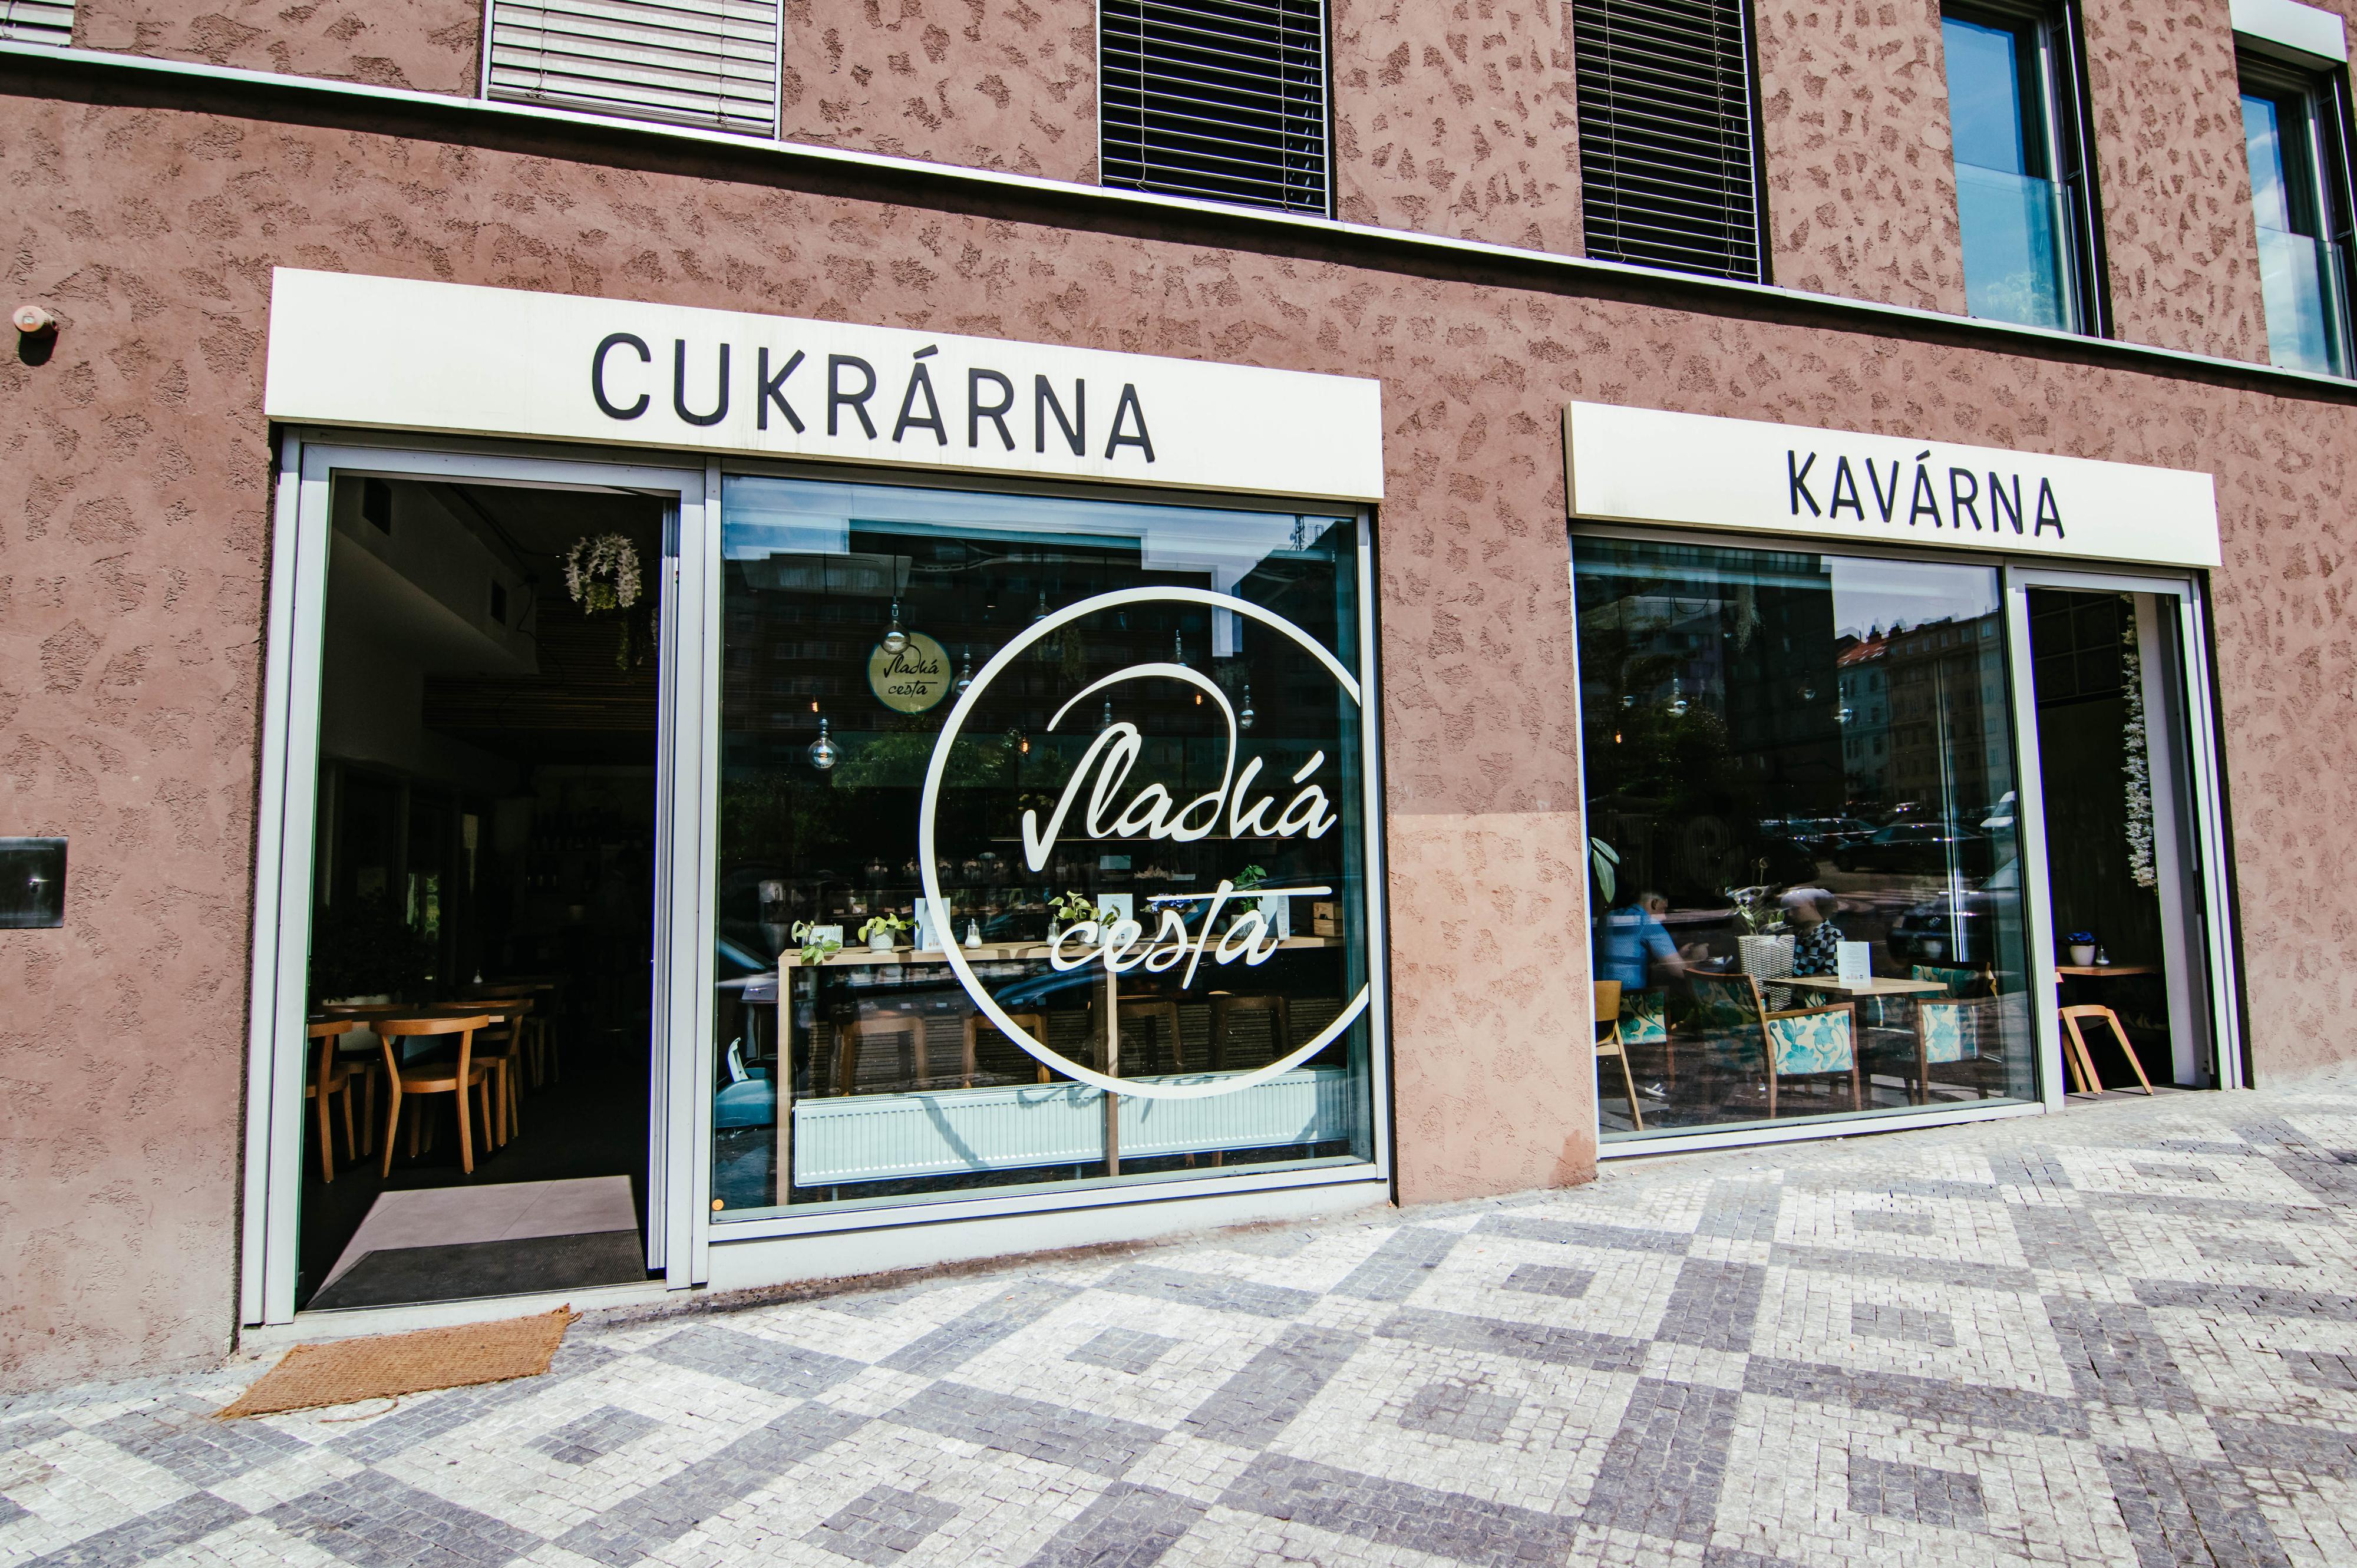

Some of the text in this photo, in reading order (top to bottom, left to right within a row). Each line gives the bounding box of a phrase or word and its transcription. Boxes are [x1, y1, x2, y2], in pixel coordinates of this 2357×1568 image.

[592, 332, 1156, 463] CUKRÁRNA
[1788, 450, 2065, 539] KAVÁRNA
[888, 680, 938, 698] cesta
[1050, 880, 1332, 989] cesta
